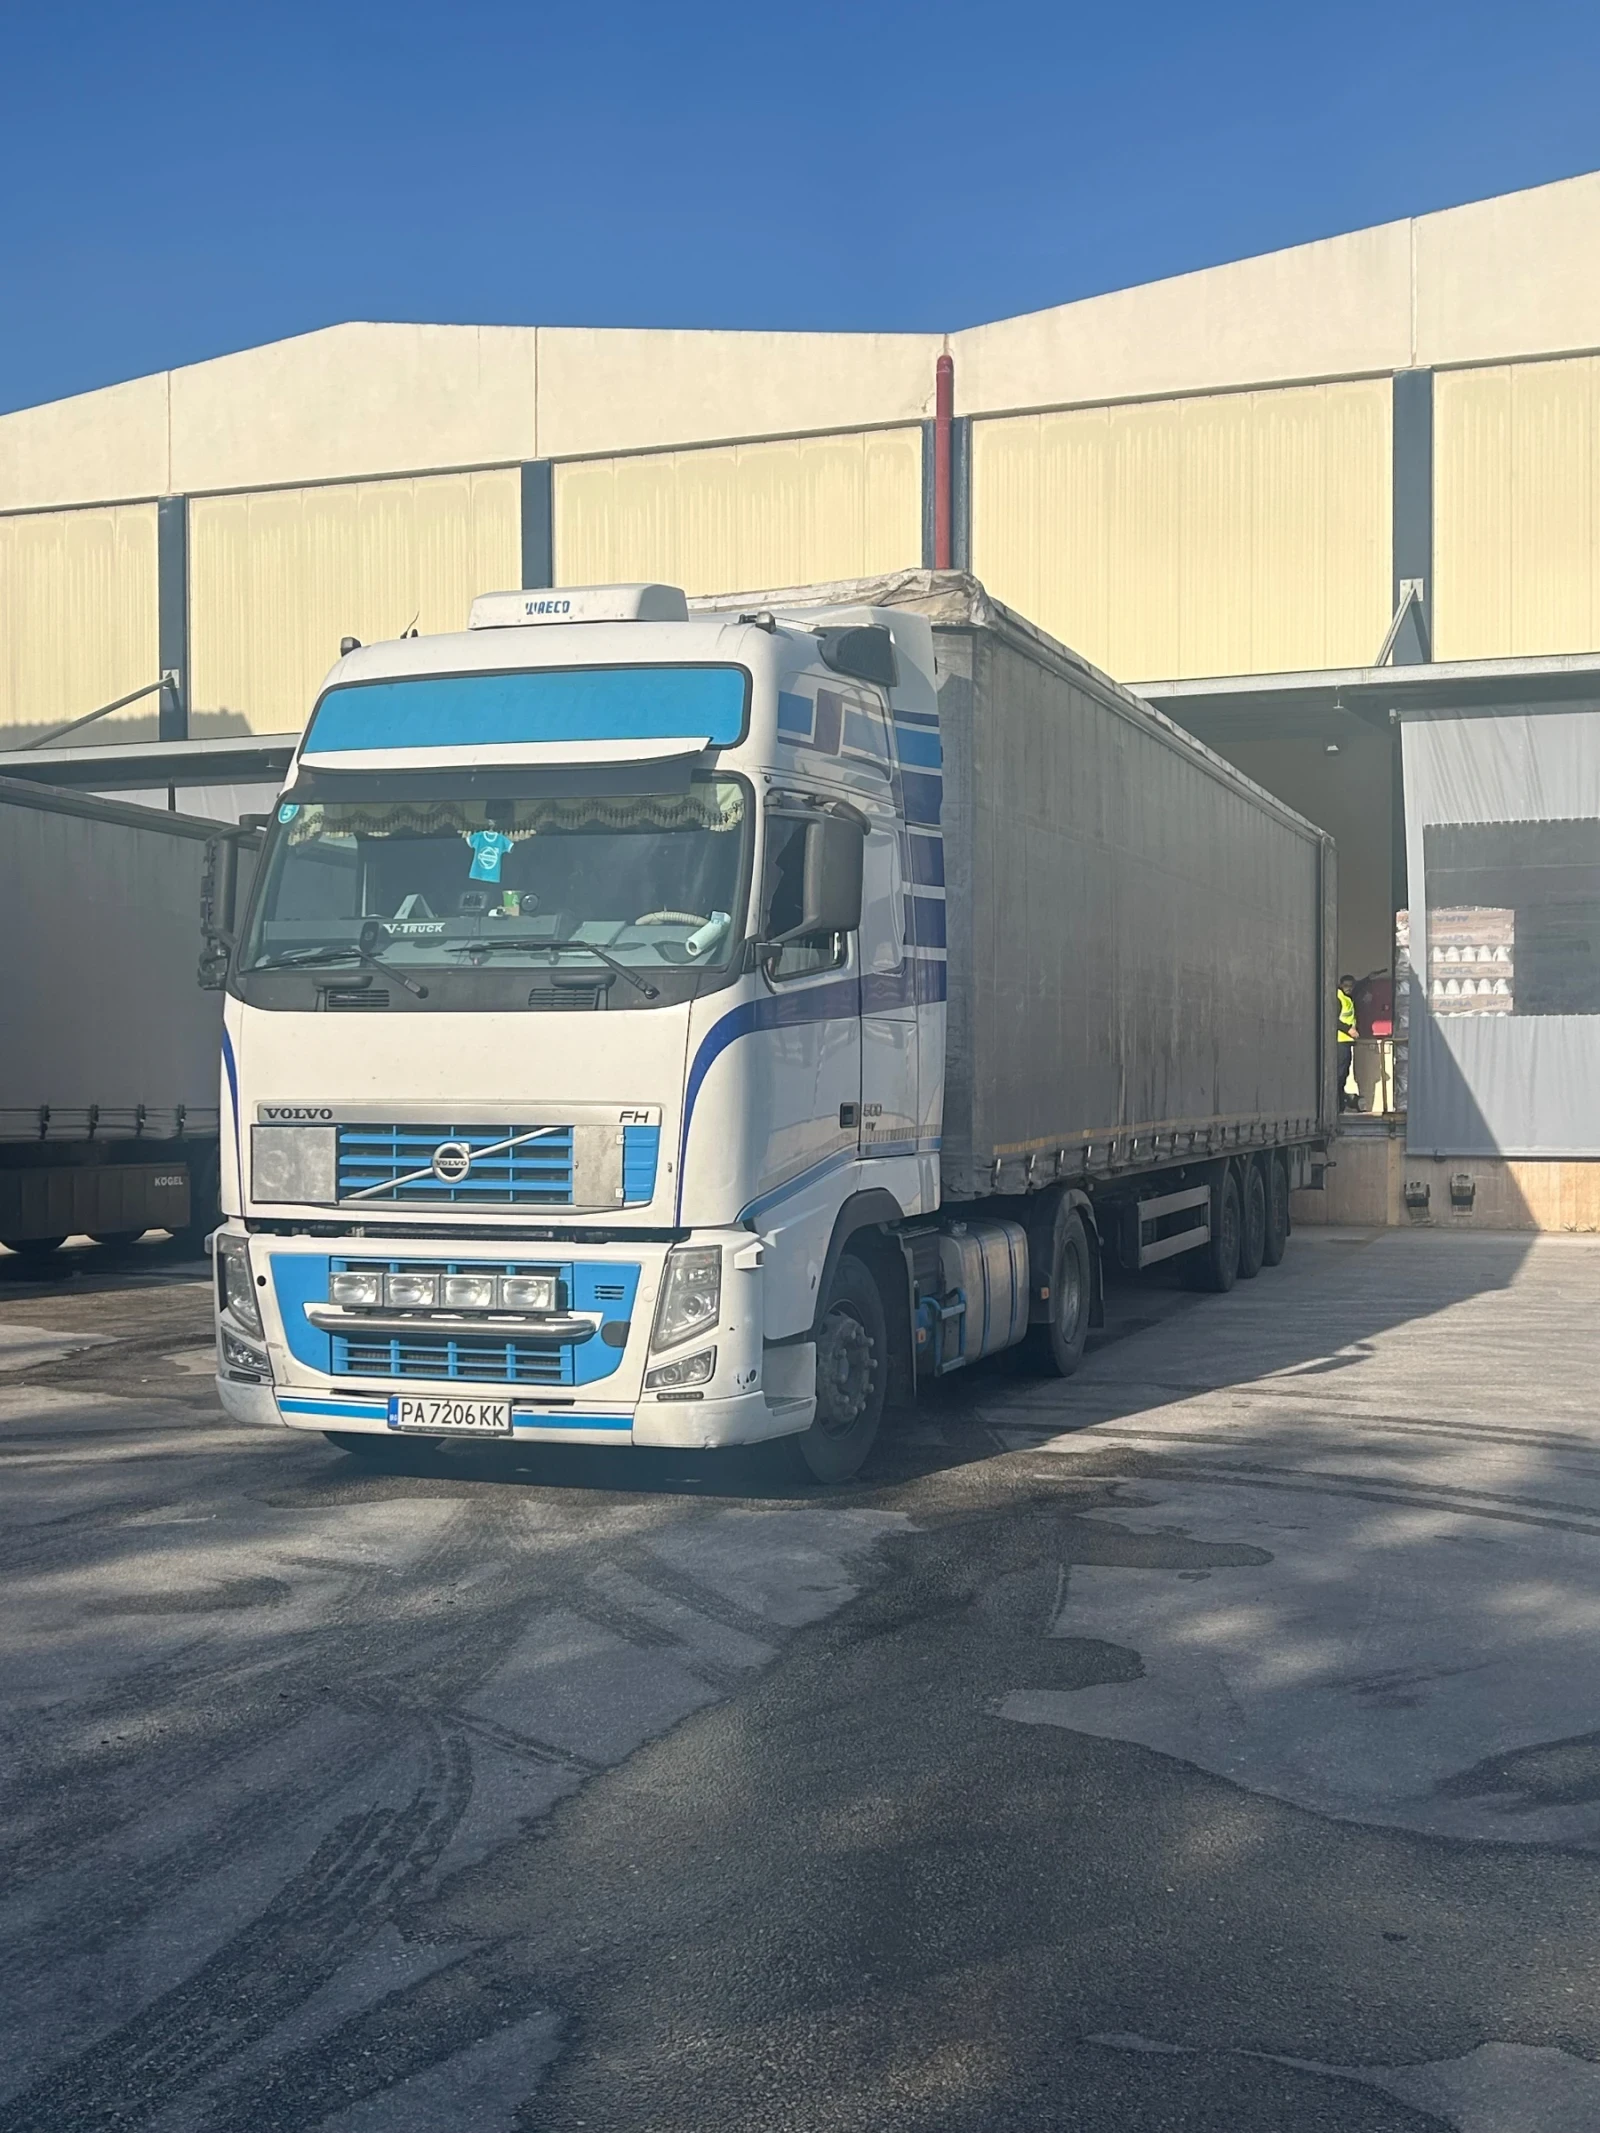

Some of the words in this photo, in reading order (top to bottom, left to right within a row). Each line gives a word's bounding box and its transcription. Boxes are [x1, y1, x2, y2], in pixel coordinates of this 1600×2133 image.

[525, 600, 571, 615] WAECO
[263, 1107, 333, 1120] VOLVO
[619, 1110, 649, 1123] FH
